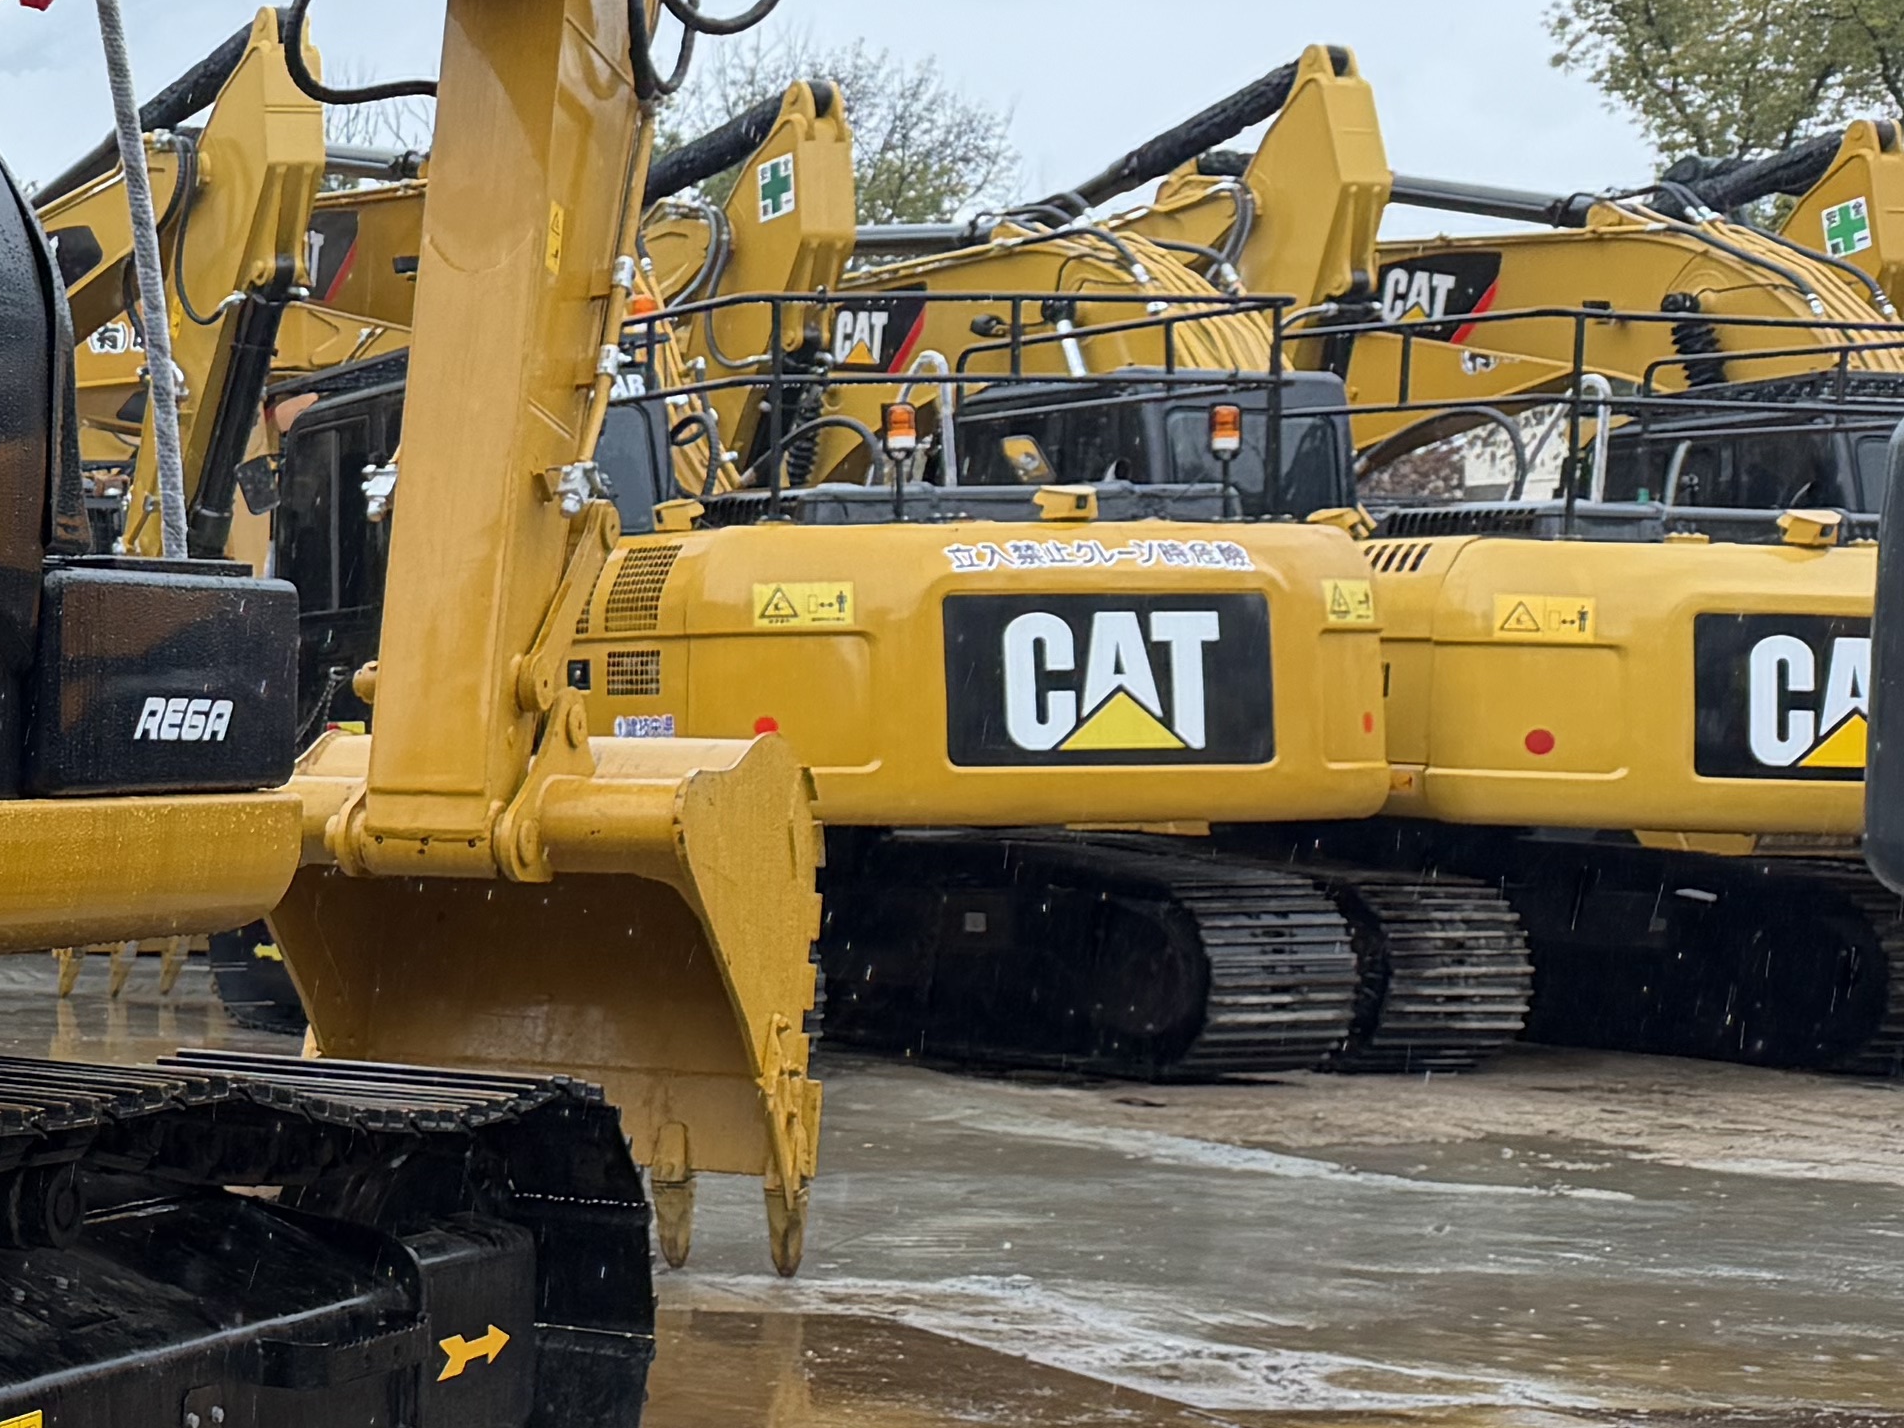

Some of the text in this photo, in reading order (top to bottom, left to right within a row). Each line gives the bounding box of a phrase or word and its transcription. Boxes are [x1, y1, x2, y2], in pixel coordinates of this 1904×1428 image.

[1382, 267, 1456, 323] CAT
[834, 310, 889, 365] CAT
[1003, 611, 1220, 751] CAT
